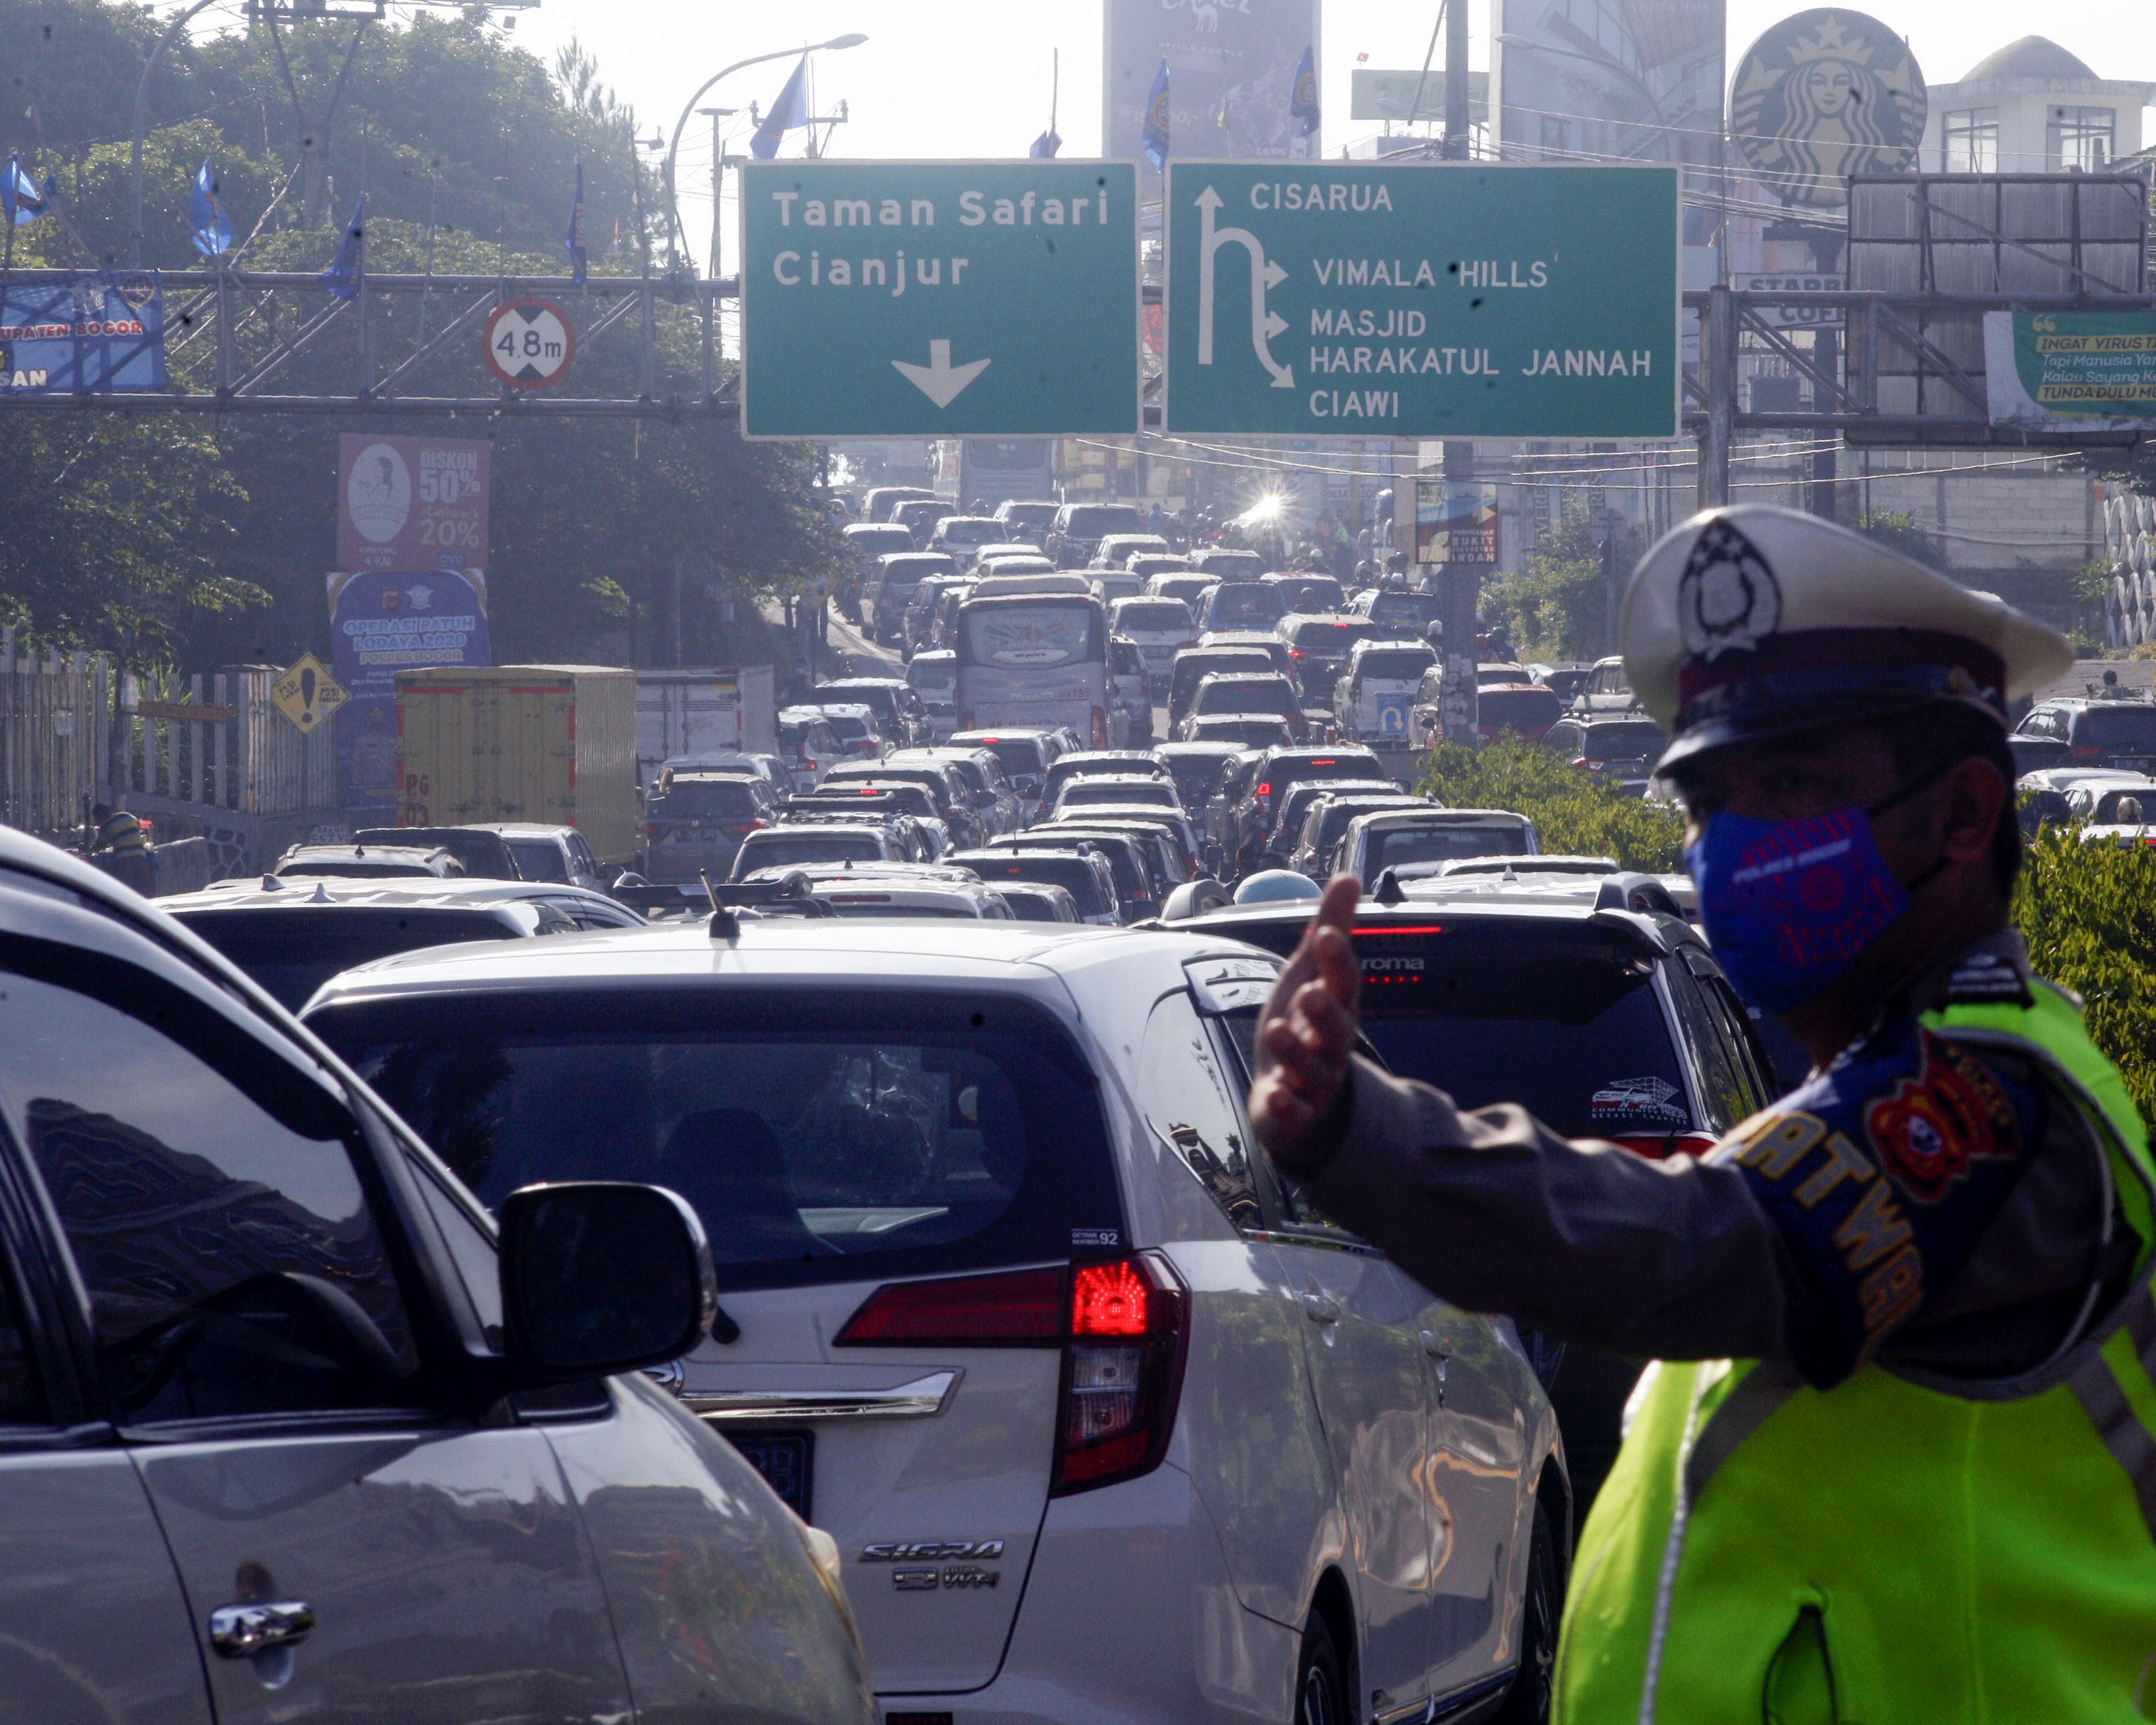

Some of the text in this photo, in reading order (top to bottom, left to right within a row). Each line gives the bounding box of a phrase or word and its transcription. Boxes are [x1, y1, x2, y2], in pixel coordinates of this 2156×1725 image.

[1250, 182, 1394, 212] CISARUA
[772, 190, 1108, 227] Taman Safari
[773, 250, 969, 298] Cianjur
[1313, 258, 1548, 288] VIMALA HILLS
[75, 320, 144, 337] BOGOR
[1311, 309, 1426, 338] MASJID
[2041, 338, 2089, 350] INGAT
[2095, 336, 2142, 349] VIRUS
[1310, 347, 1652, 377] HARAKATUL JANNAH
[2043, 354, 2071, 370] Tapi
[2073, 354, 2132, 366] Manusia
[2043, 370, 2083, 383] Kalau
[2086, 370, 2140, 386] Sayang
[2043, 387, 2093, 399] TUNDA
[2096, 386, 2136, 399] DULU
[1310, 390, 1399, 418] CIAWI
[420, 450, 478, 470] DISKON
[419, 469, 481, 504] 50%
[419, 520, 480, 547] 20%
[1452, 537, 1493, 545] BUKIT
[1452, 553, 1495, 562] INDAH
[343, 616, 475, 636] OPERASI PATUH
[353, 633, 468, 651] LODAYA 2020
[414, 649, 464, 663] BOGOR
[1099, 1232, 1118, 1245] 92
[1726, 1110, 1924, 1366] ATWA
[859, 1540, 1005, 1563] SIGRA
